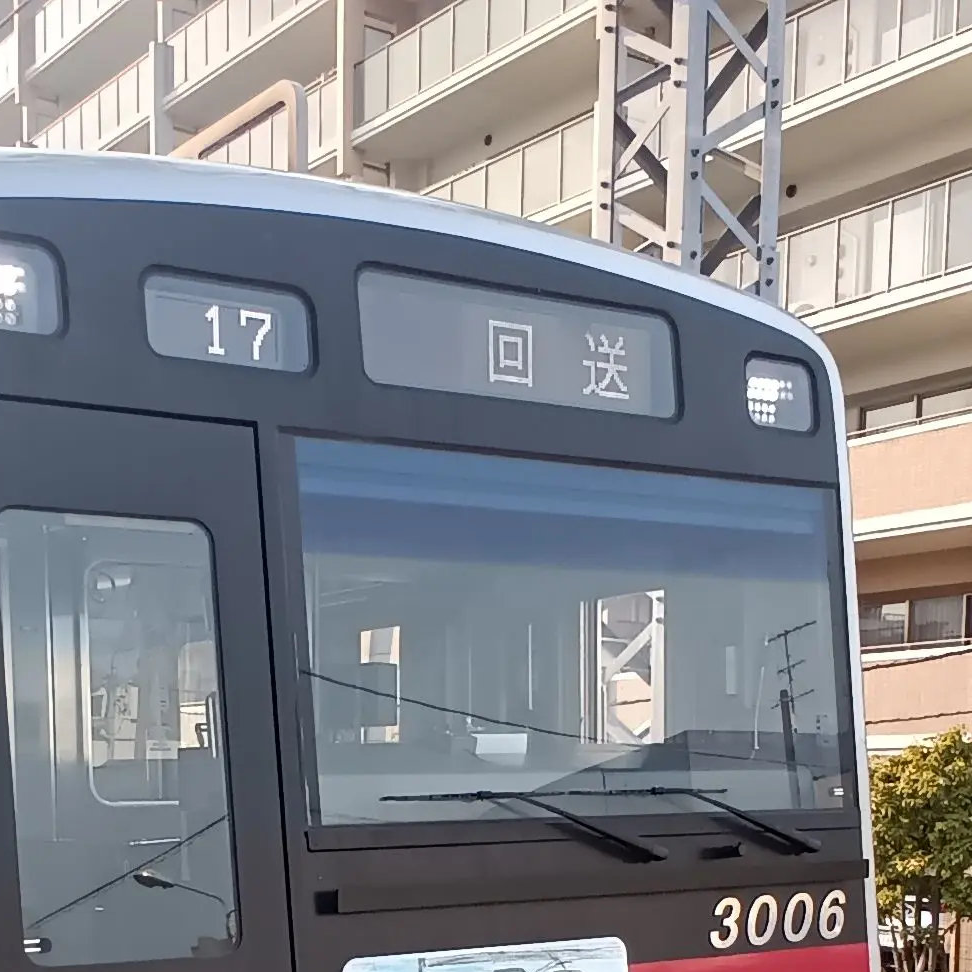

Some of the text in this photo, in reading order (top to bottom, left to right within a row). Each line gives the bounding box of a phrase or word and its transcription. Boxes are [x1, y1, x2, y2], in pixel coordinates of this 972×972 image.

[204, 305, 274, 361] 17
[488, 320, 630, 400] 回送
[709, 889, 847, 949] 3006
